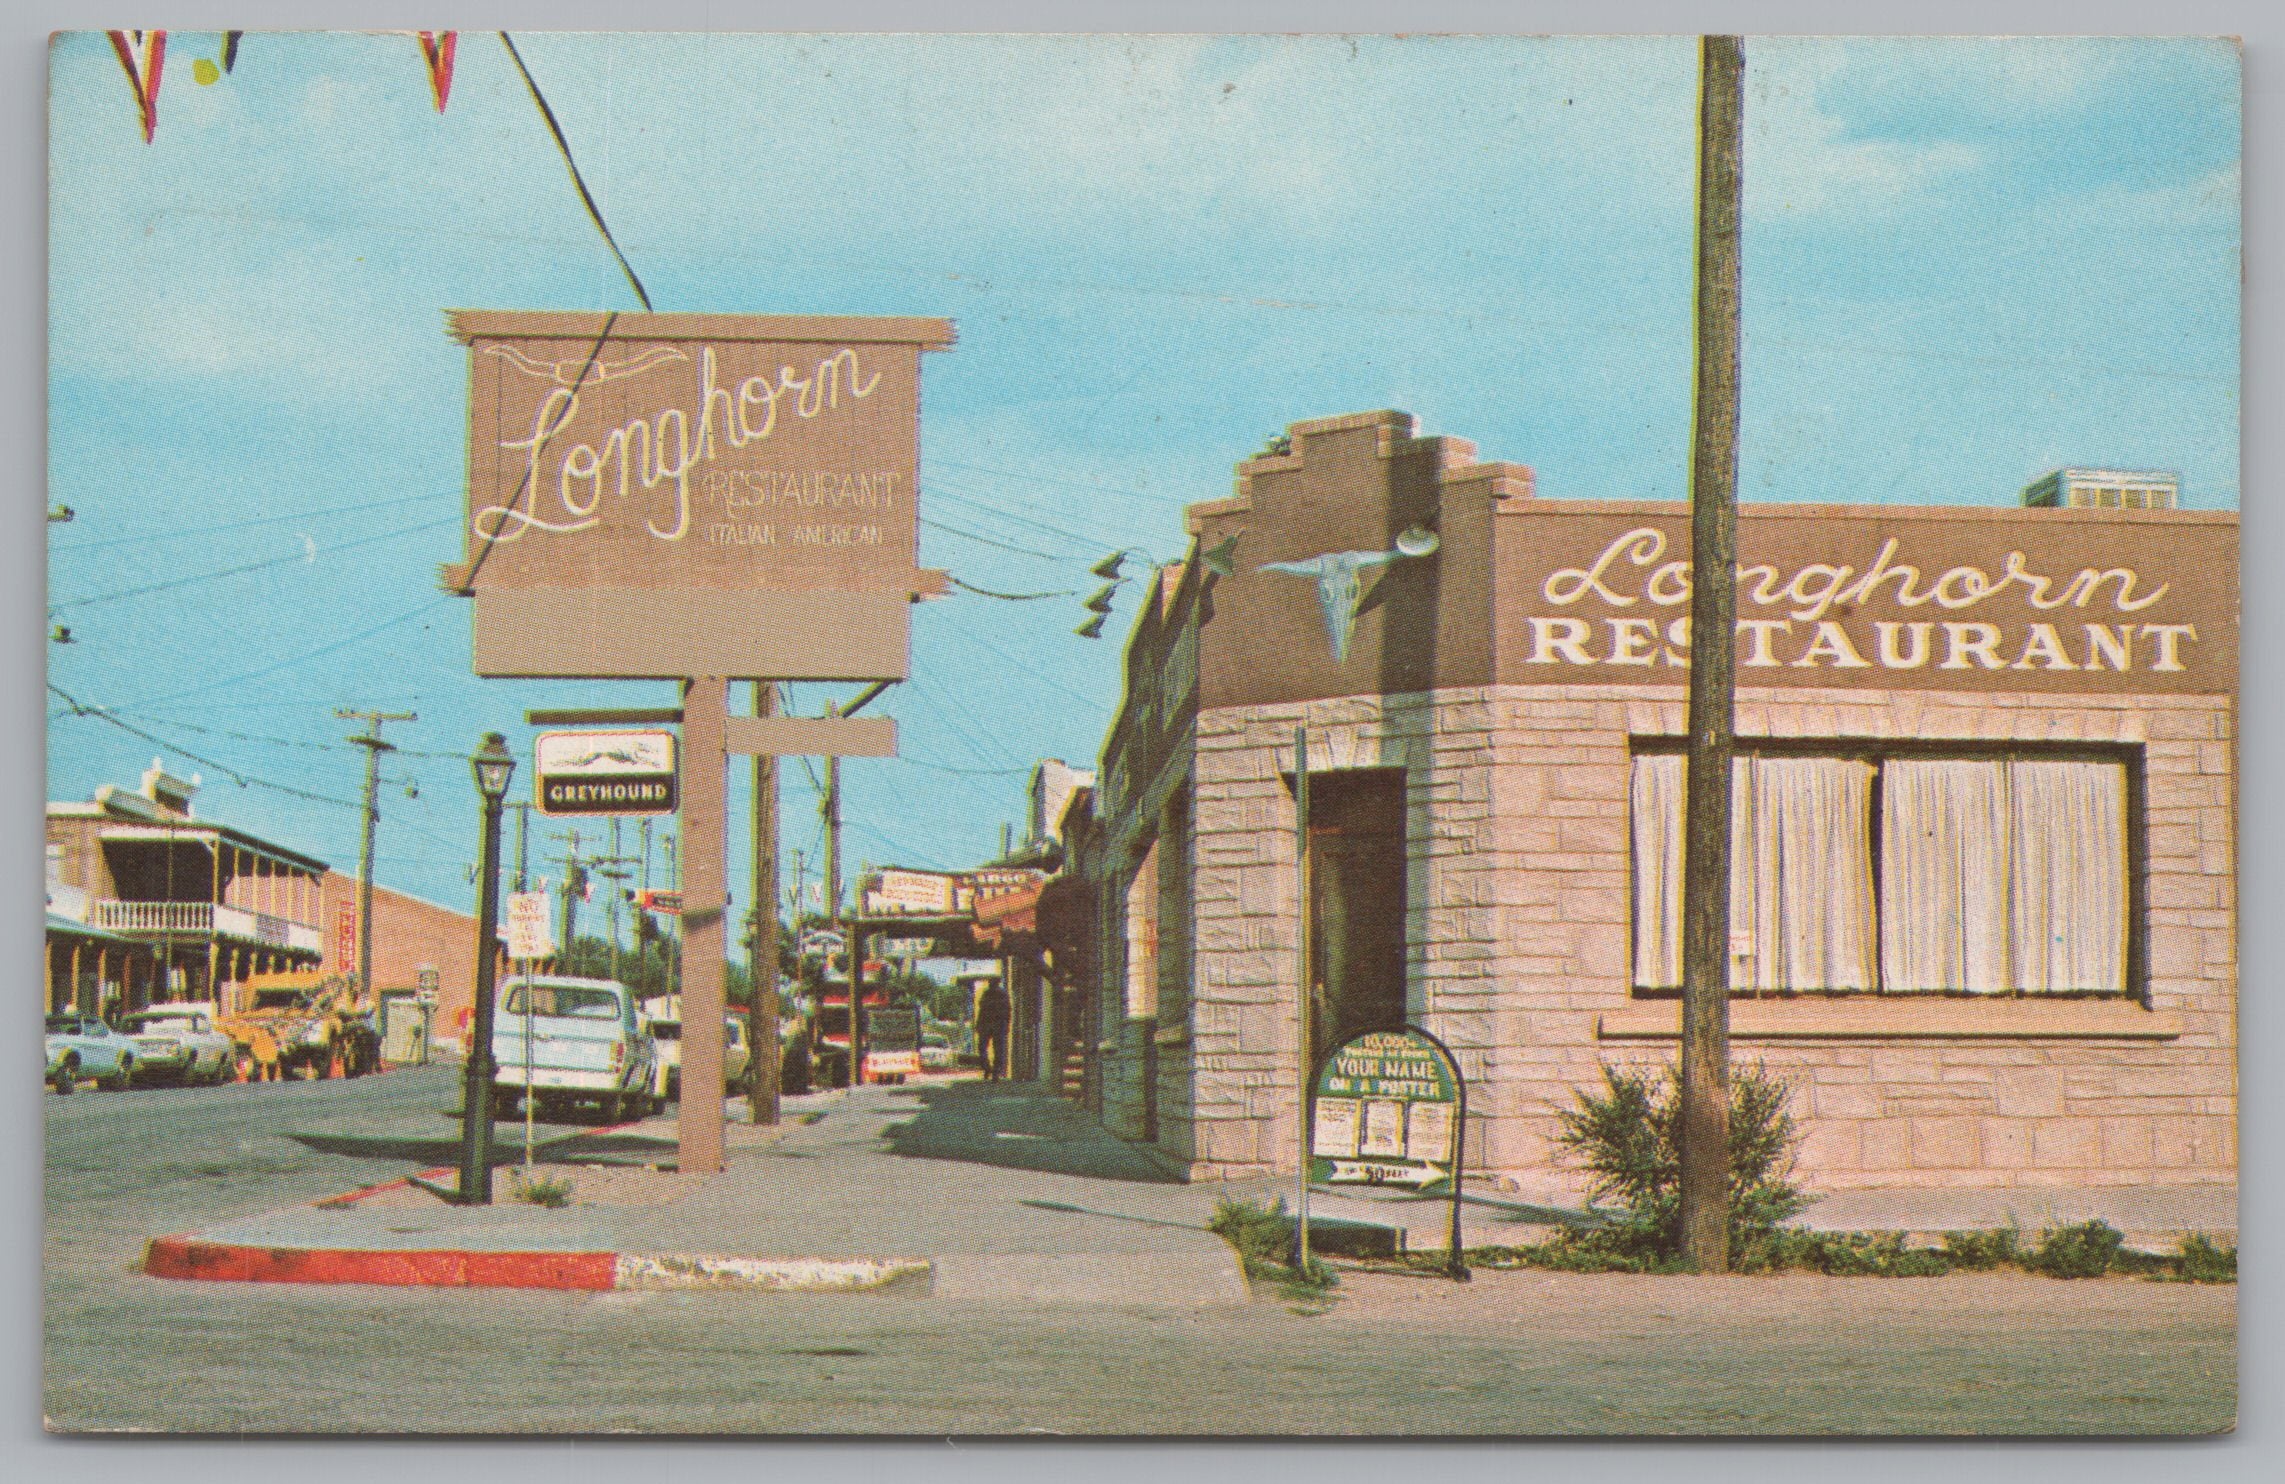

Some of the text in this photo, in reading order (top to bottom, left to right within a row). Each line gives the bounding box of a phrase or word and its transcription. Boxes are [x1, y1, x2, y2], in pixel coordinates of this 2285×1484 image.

[474, 346, 882, 542] Longhorn
[702, 469, 902, 519] RESTAURANT
[709, 522, 884, 546] ITALIAN AMERICAN
[1541, 527, 2171, 622] Longhorn
[1524, 616, 2198, 673] RESTAURANT
[550, 783, 668, 801] GREYHOUND
[1336, 1057, 1438, 1080] YOUR NAME
[1329, 1077, 1441, 1098] ON A POSTER
